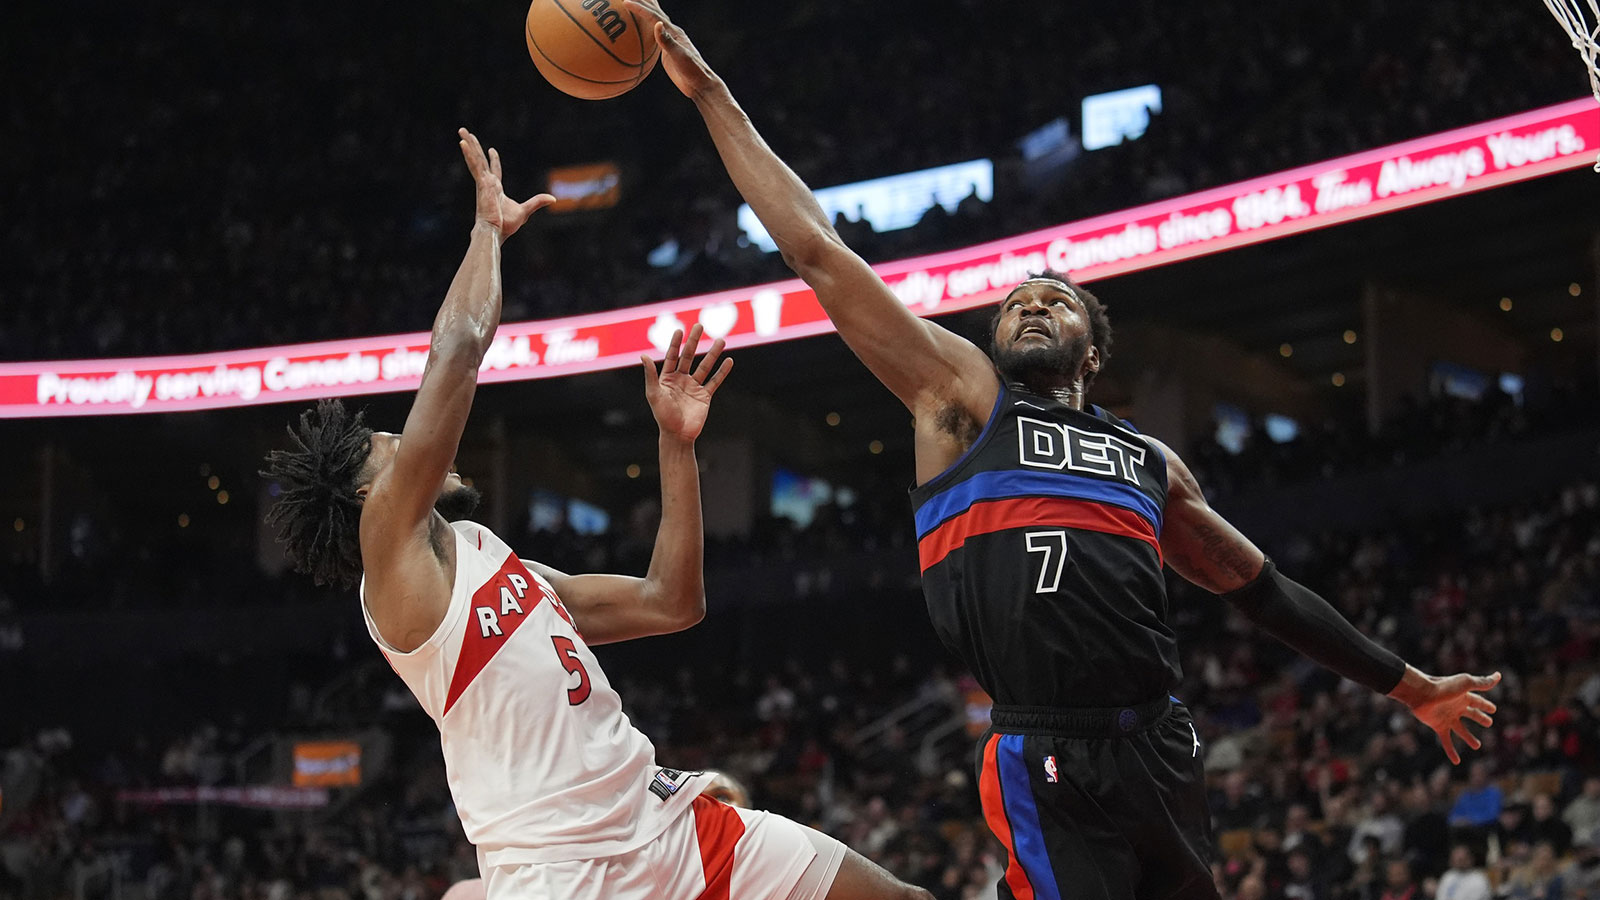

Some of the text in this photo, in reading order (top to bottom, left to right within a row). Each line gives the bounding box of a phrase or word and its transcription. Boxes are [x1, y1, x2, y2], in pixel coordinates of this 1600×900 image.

[1047, 223, 1157, 273] Canada
[1158, 210, 1232, 250] since
[1233, 184, 1311, 231] 1964.
[1312, 170, 1373, 213] Tims
[1376, 146, 1486, 198] Always
[1486, 124, 1585, 170] Yours.
[37, 372, 153, 408] Proudly
[155, 363, 261, 401] serving
[263, 355, 380, 392] Canada
[1017, 416, 1146, 487] DET
[1025, 531, 1068, 594] 7
[550, 635, 592, 706] 5
